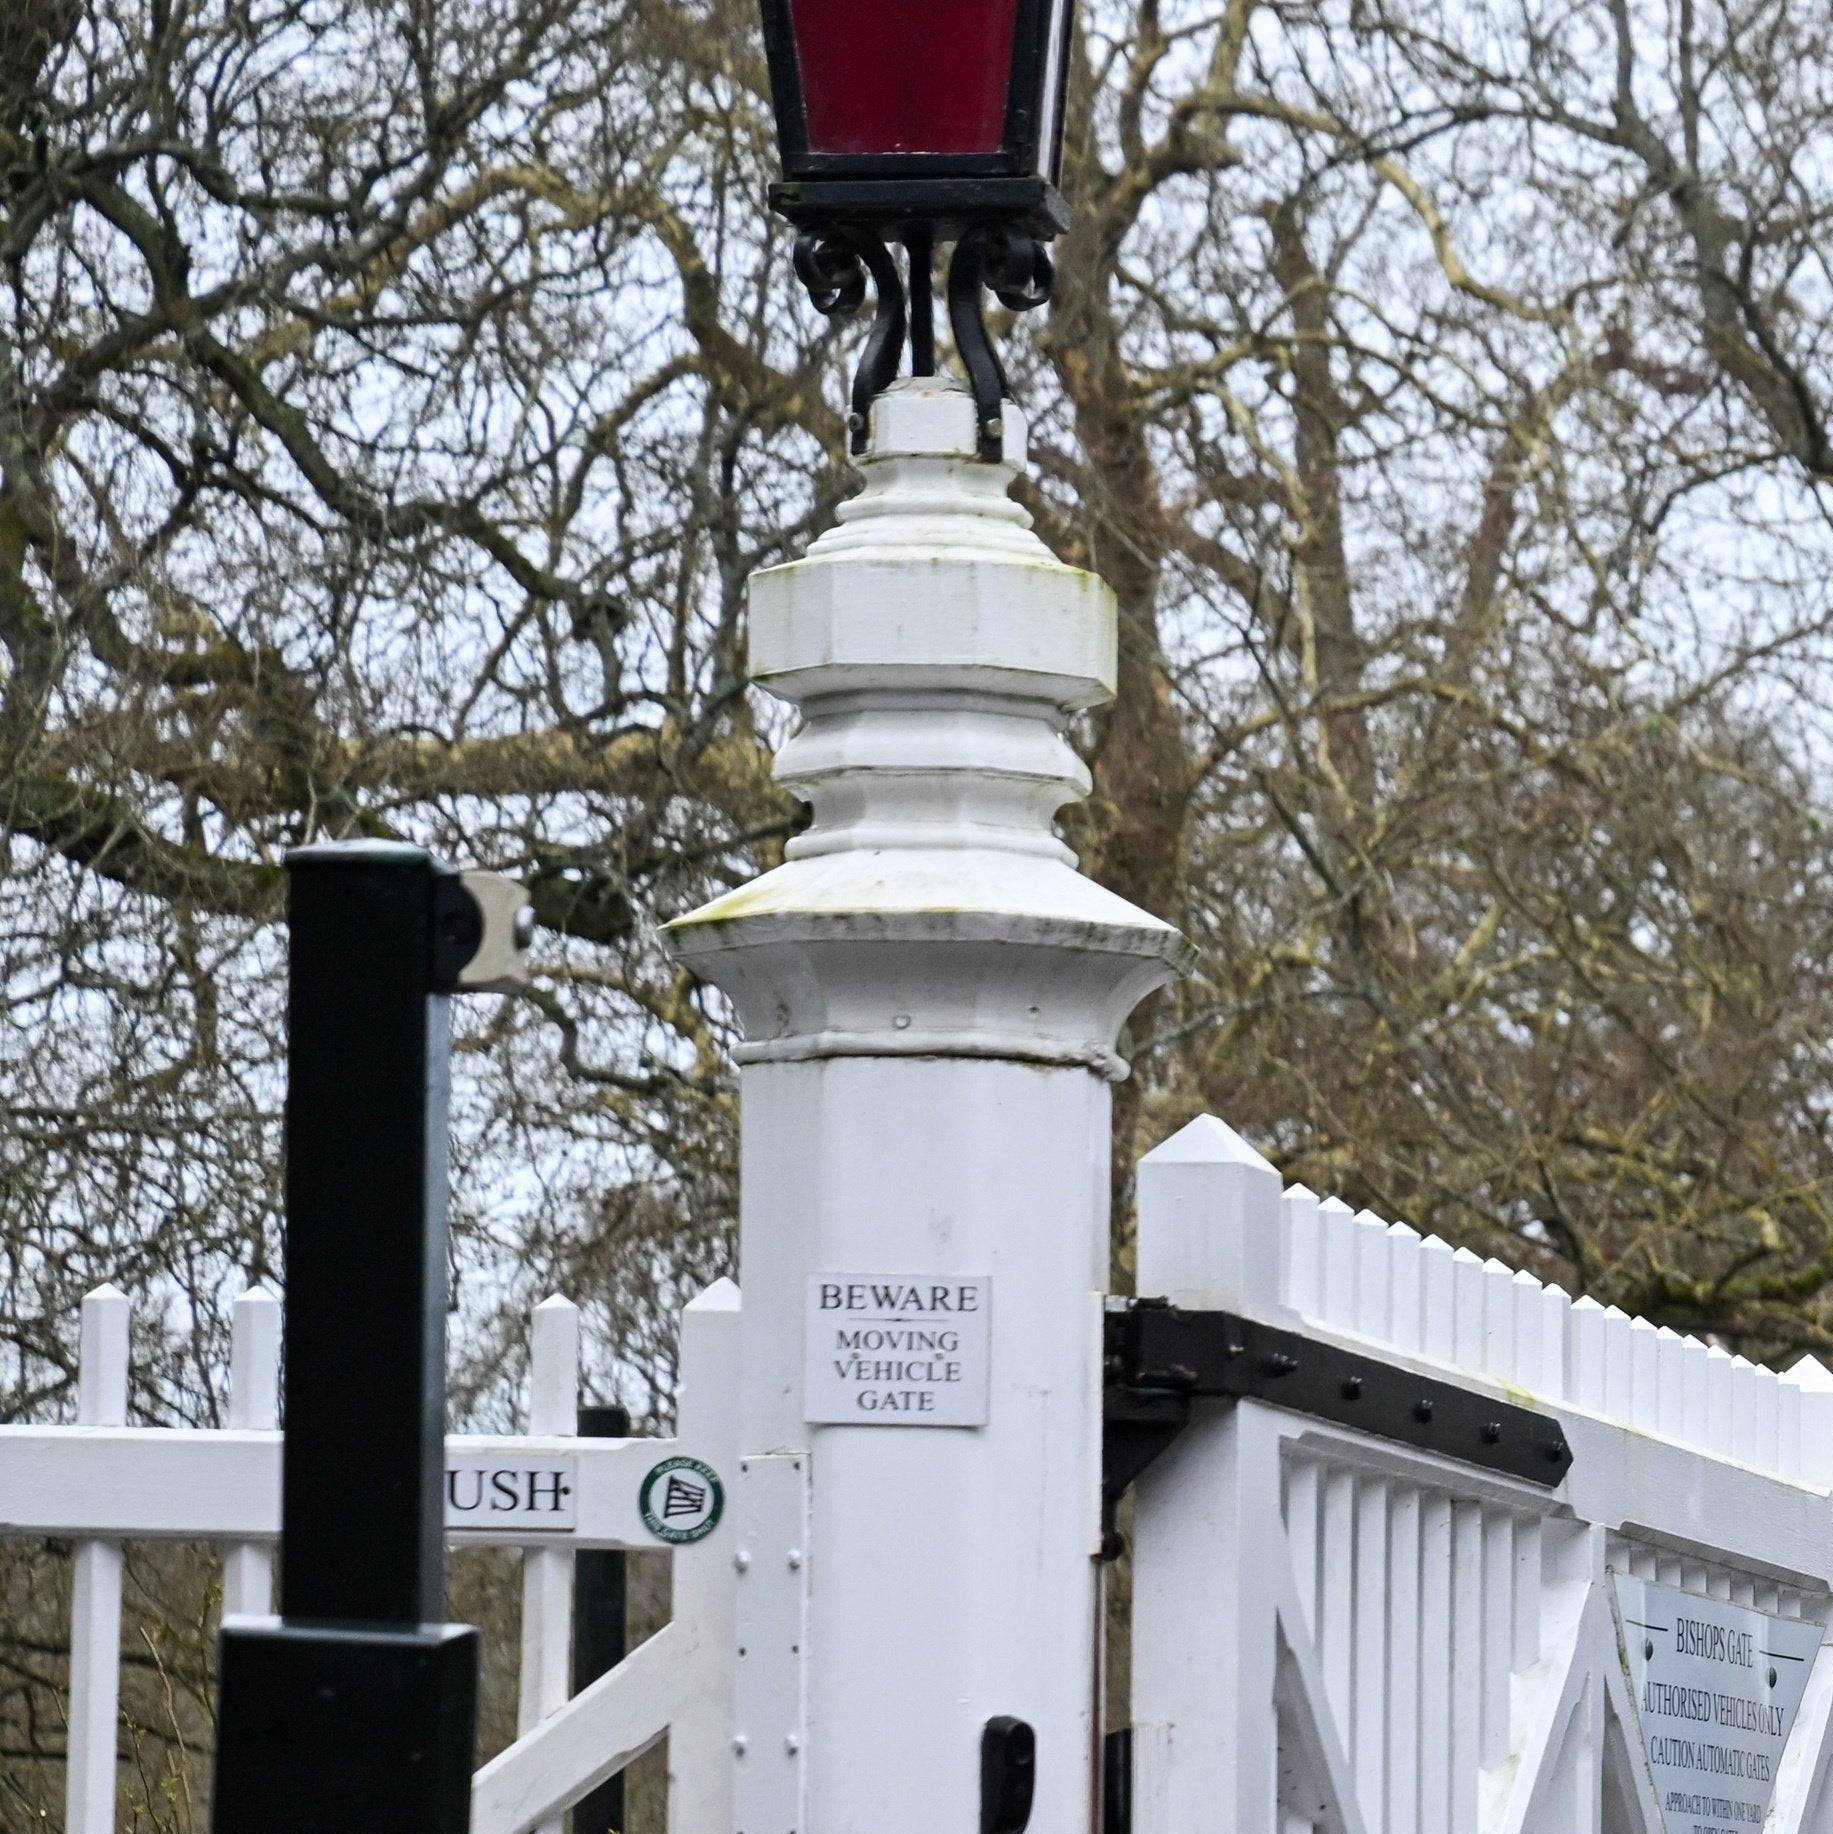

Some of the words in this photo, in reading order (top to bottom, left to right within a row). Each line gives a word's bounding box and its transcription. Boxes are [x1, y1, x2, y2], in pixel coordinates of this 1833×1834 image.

[819, 1284, 979, 1312] BEWARE
[836, 1330, 959, 1352] MOVING
[834, 1360, 963, 1382] VEHICLE
[857, 1390, 936, 1412] GATE
[444, 1469, 566, 1512] USH
[1676, 1618, 1725, 1662] BISHOPS
[1727, 1630, 1753, 1668] GATE
[1641, 1681, 1711, 1722] AUTHORISED
[1713, 1694, 1757, 1732] VEHICLES
[1758, 1703, 1784, 1737] ONLY
[1650, 1735, 1695, 1769] CAUTION
[1696, 1743, 1744, 1778] AUTOMATIC
[1746, 1752, 1770, 1782] GATES
[1665, 1791, 1701, 1815] APPROACH
[1702, 1796, 1711, 1816] TO
[1711, 1798, 1733, 1819] WITHIN
[1734, 1801, 1746, 1821] ONE
[1746, 1803, 1762, 1824] YARD
